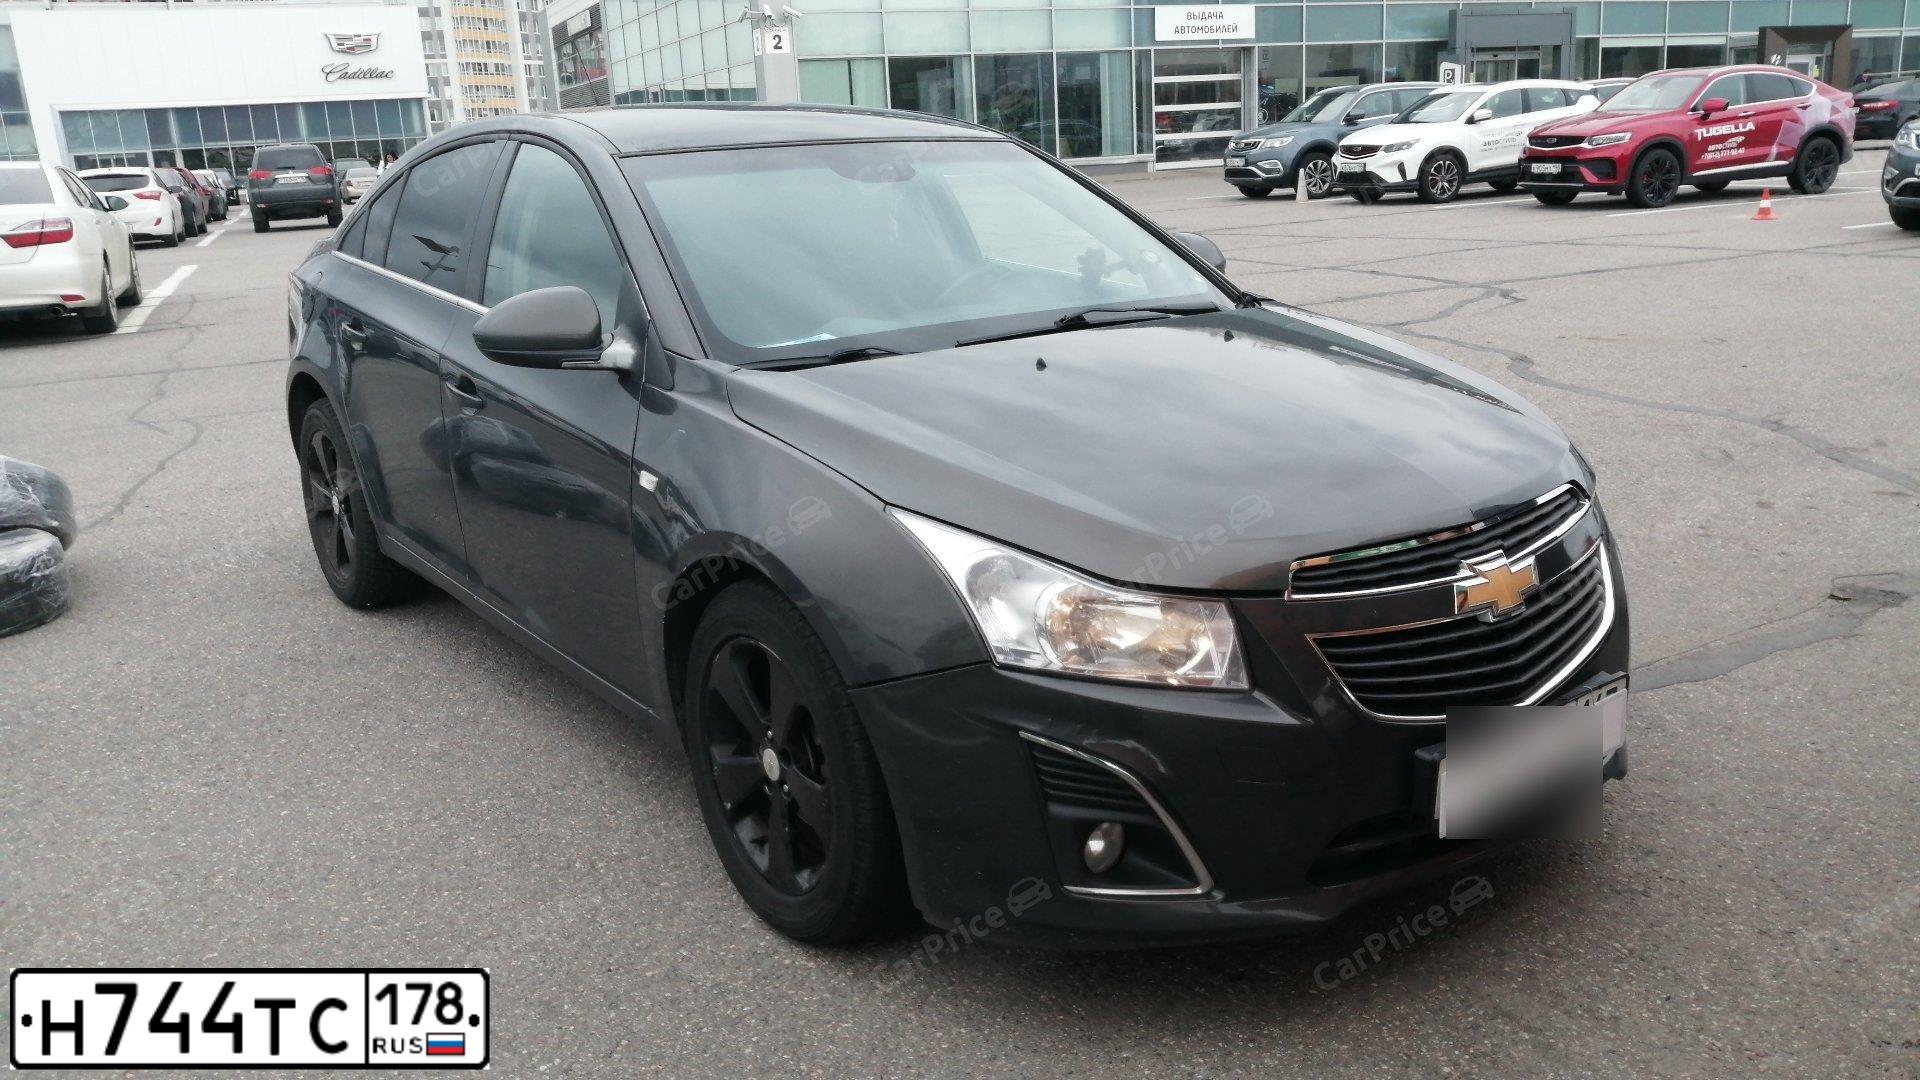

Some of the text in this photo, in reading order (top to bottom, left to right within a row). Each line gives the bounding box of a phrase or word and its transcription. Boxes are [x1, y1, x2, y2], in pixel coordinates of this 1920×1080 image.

[1186, 11, 1224, 21] ВЫДАЧА
[1174, 22, 1238, 35] АВТОМОБИЛЕЙ
[773, 34, 783, 50] 2
[321, 62, 395, 83] Cadillac
[1694, 121, 1755, 141] TUGELLA
